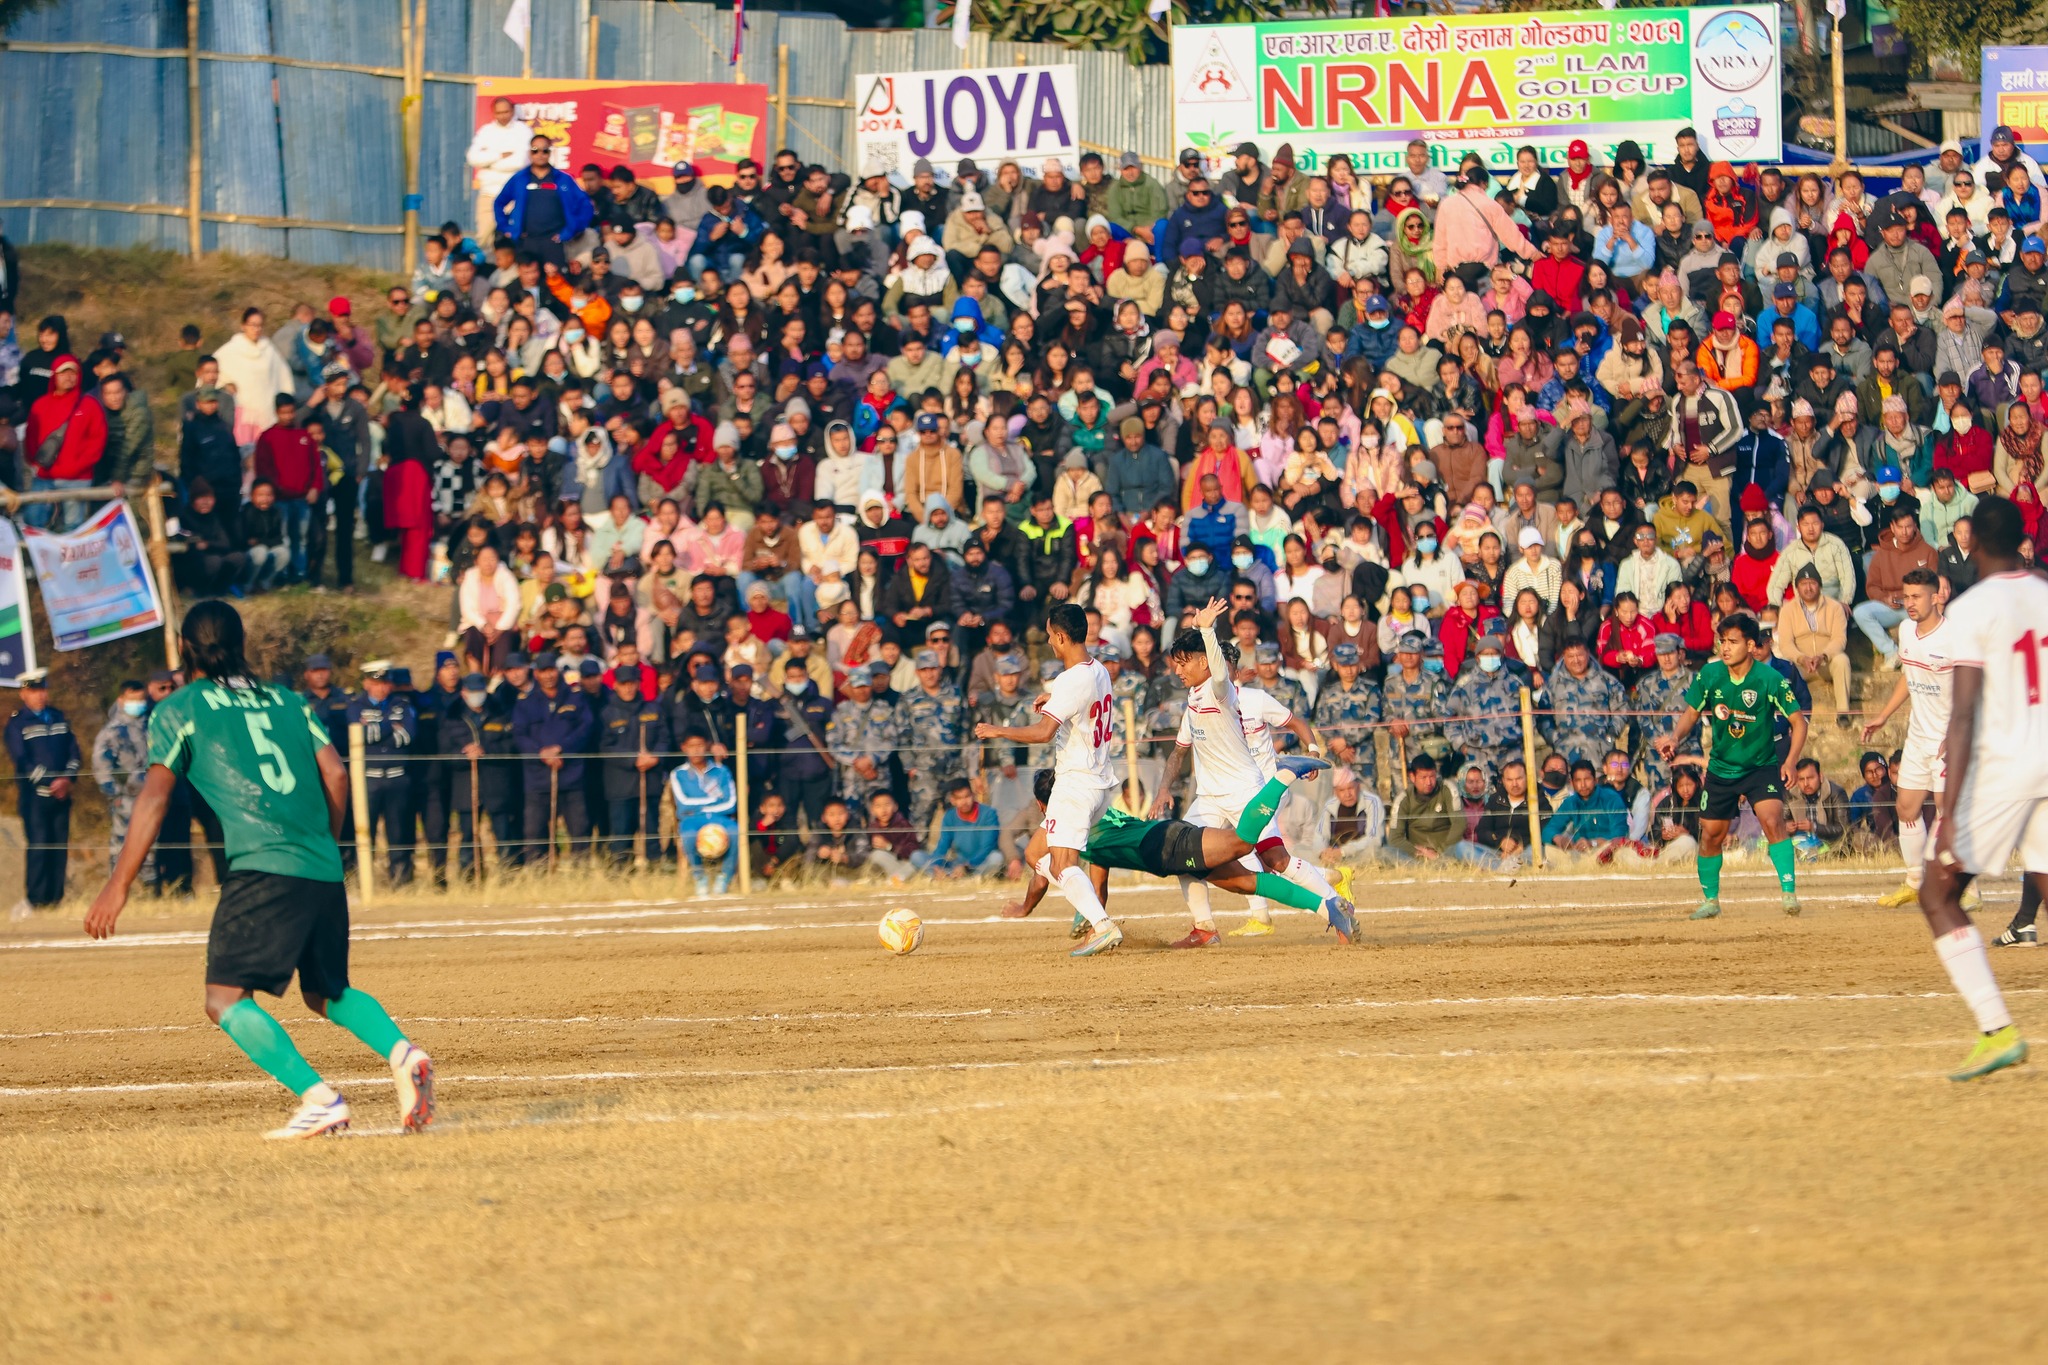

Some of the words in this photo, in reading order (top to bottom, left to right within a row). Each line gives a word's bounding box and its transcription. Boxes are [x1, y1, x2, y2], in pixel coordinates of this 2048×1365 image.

[1456, 28, 1513, 51] इलाम
[1520, 18, 1611, 46] गोल्डकप
[1629, 21, 1682, 43] २०८१
[1518, 55, 1555, 74] 2nd
[1566, 55, 1646, 72] ILAM
[1710, 55, 1759, 68] NRNA
[1263, 60, 1509, 129] NRNA
[1518, 76, 1686, 97] GOLDCUP
[908, 71, 1071, 157] JOYA
[1518, 102, 1589, 120] 2081
[858, 118, 905, 132] JOYA
[1717, 118, 1756, 130] SPORTS
[1090, 693, 1113, 748] 32
[244, 710, 297, 796] 5
[1700, 790, 1709, 811] 8
